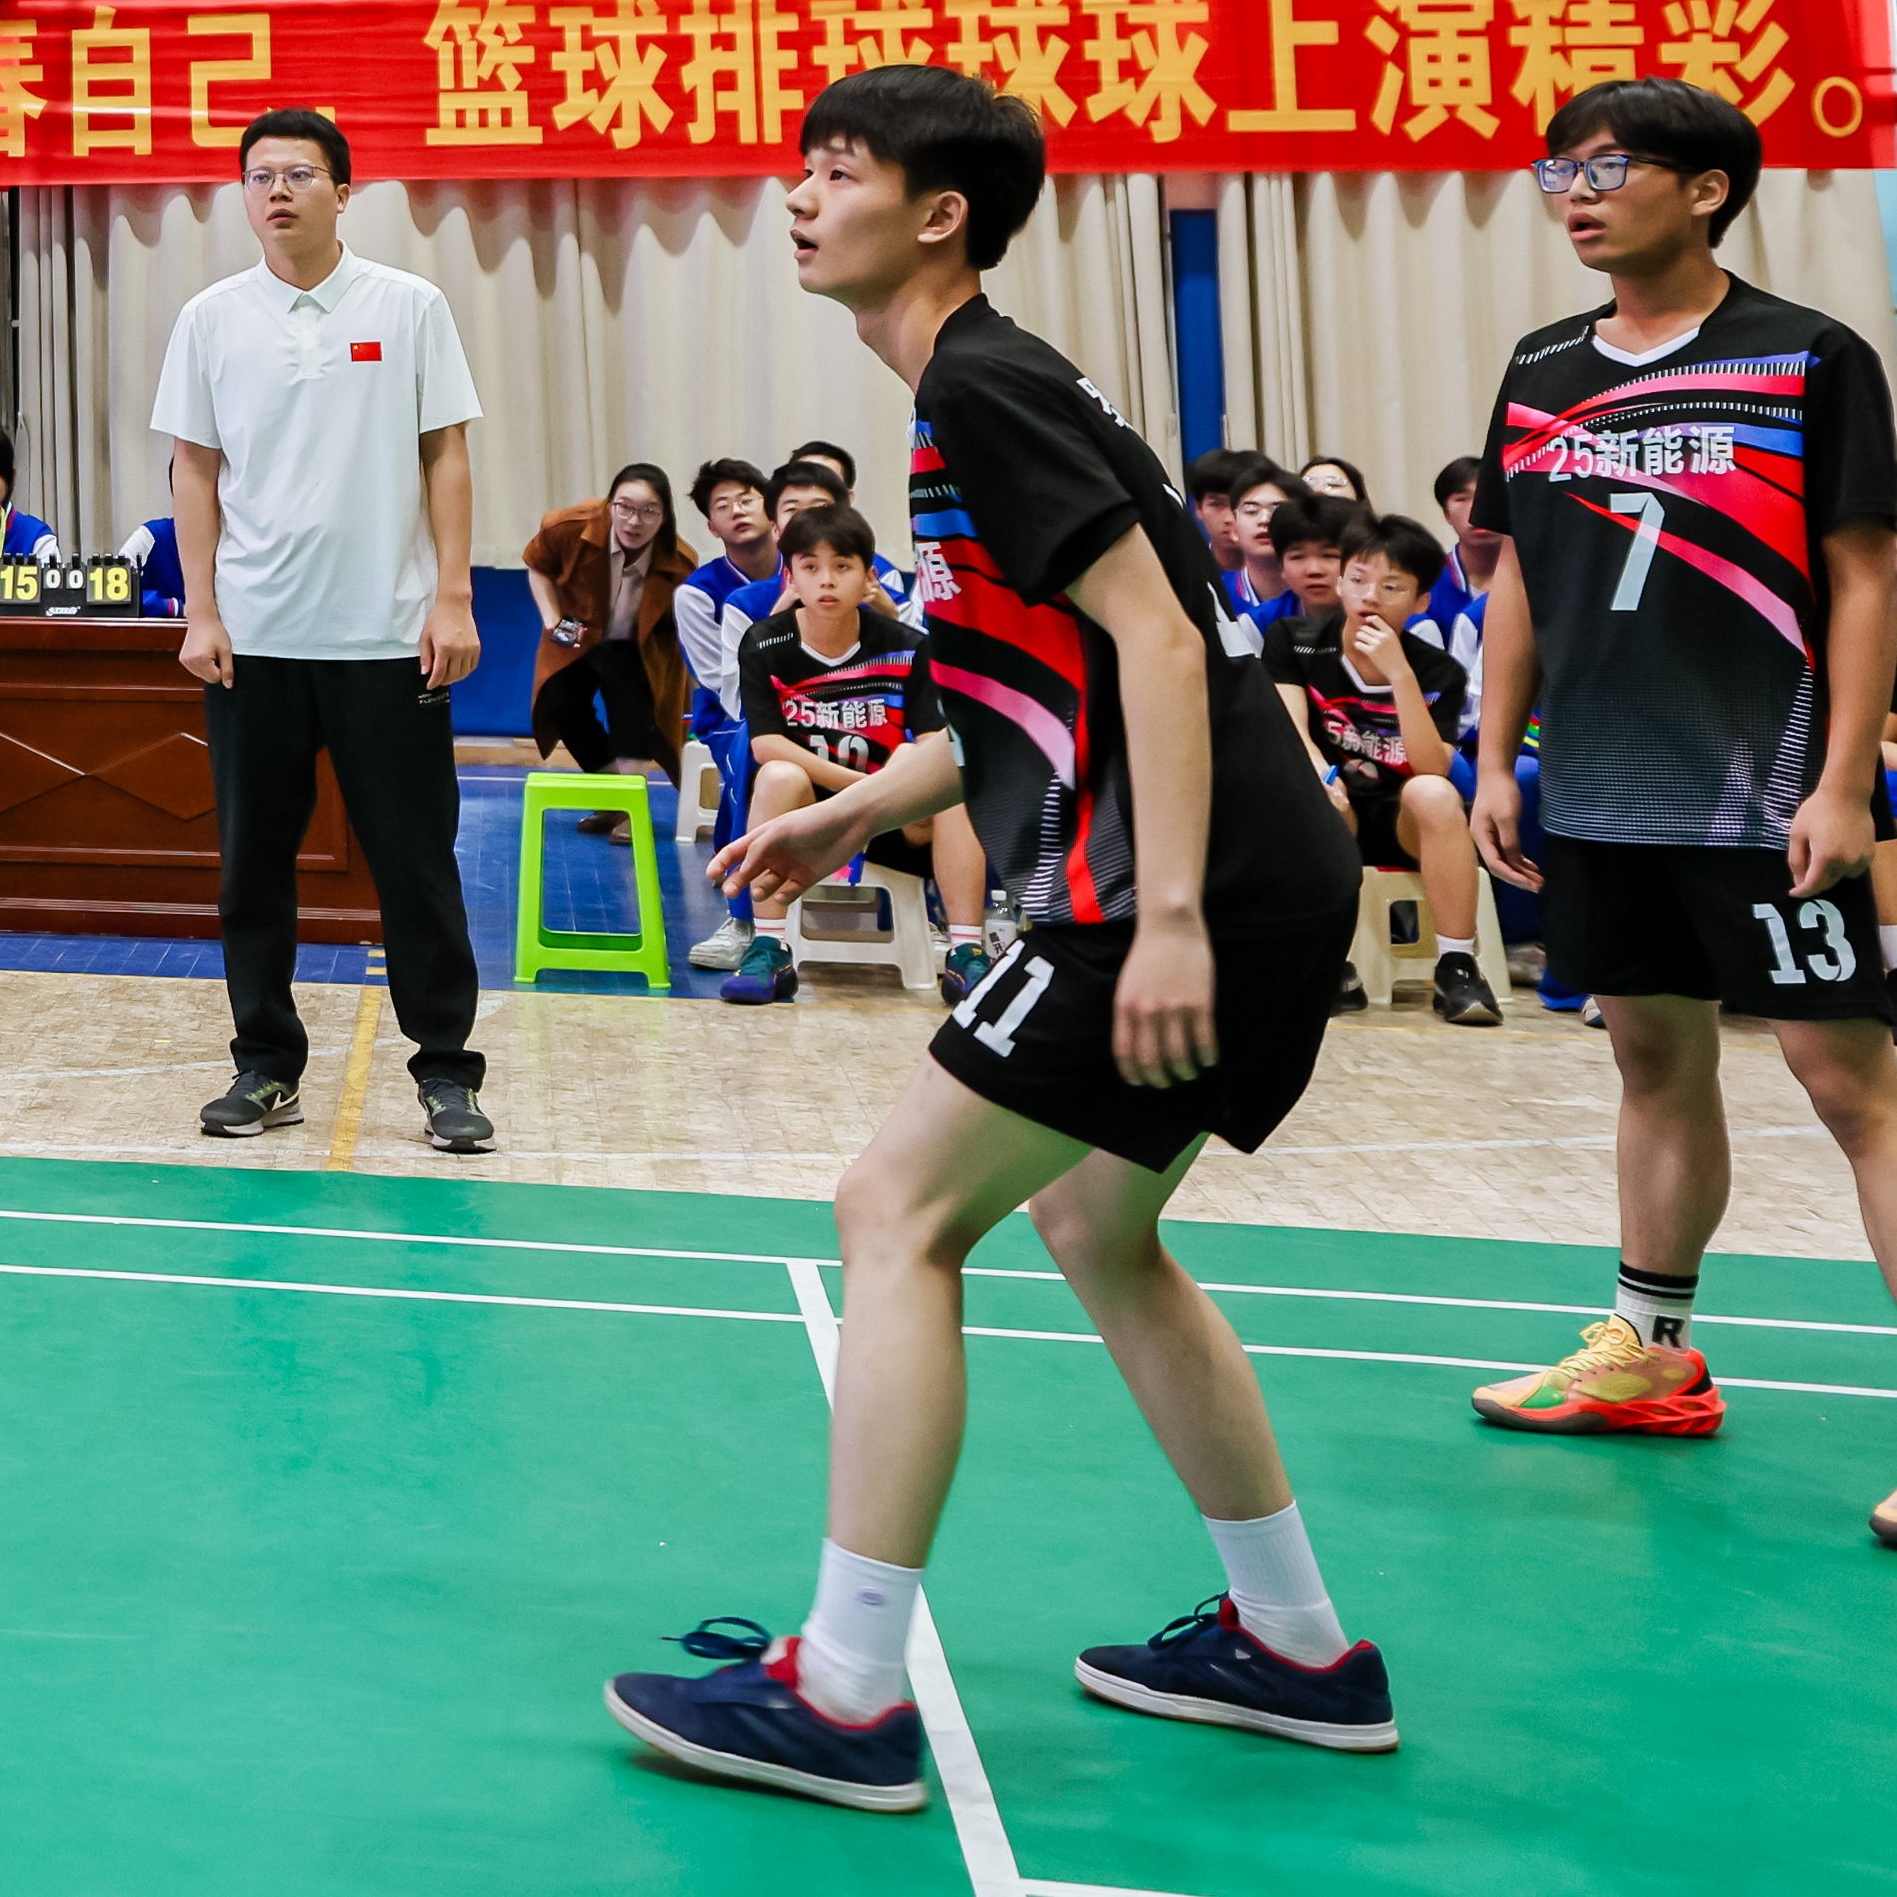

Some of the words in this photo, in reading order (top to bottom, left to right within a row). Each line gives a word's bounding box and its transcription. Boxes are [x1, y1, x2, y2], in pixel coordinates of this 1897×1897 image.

[1547, 425, 1738, 484] 25新能源
[1609, 491, 1667, 612] 7
[0, 565, 39, 601] 15
[45, 569, 62, 589] 0
[68, 569, 85, 589] 0
[89, 566, 130, 602] 18
[783, 697, 889, 730] 25新能源
[1751, 898, 1857, 985] 13
[952, 938, 1056, 1059] 11
[1652, 1315, 1686, 1348] R
